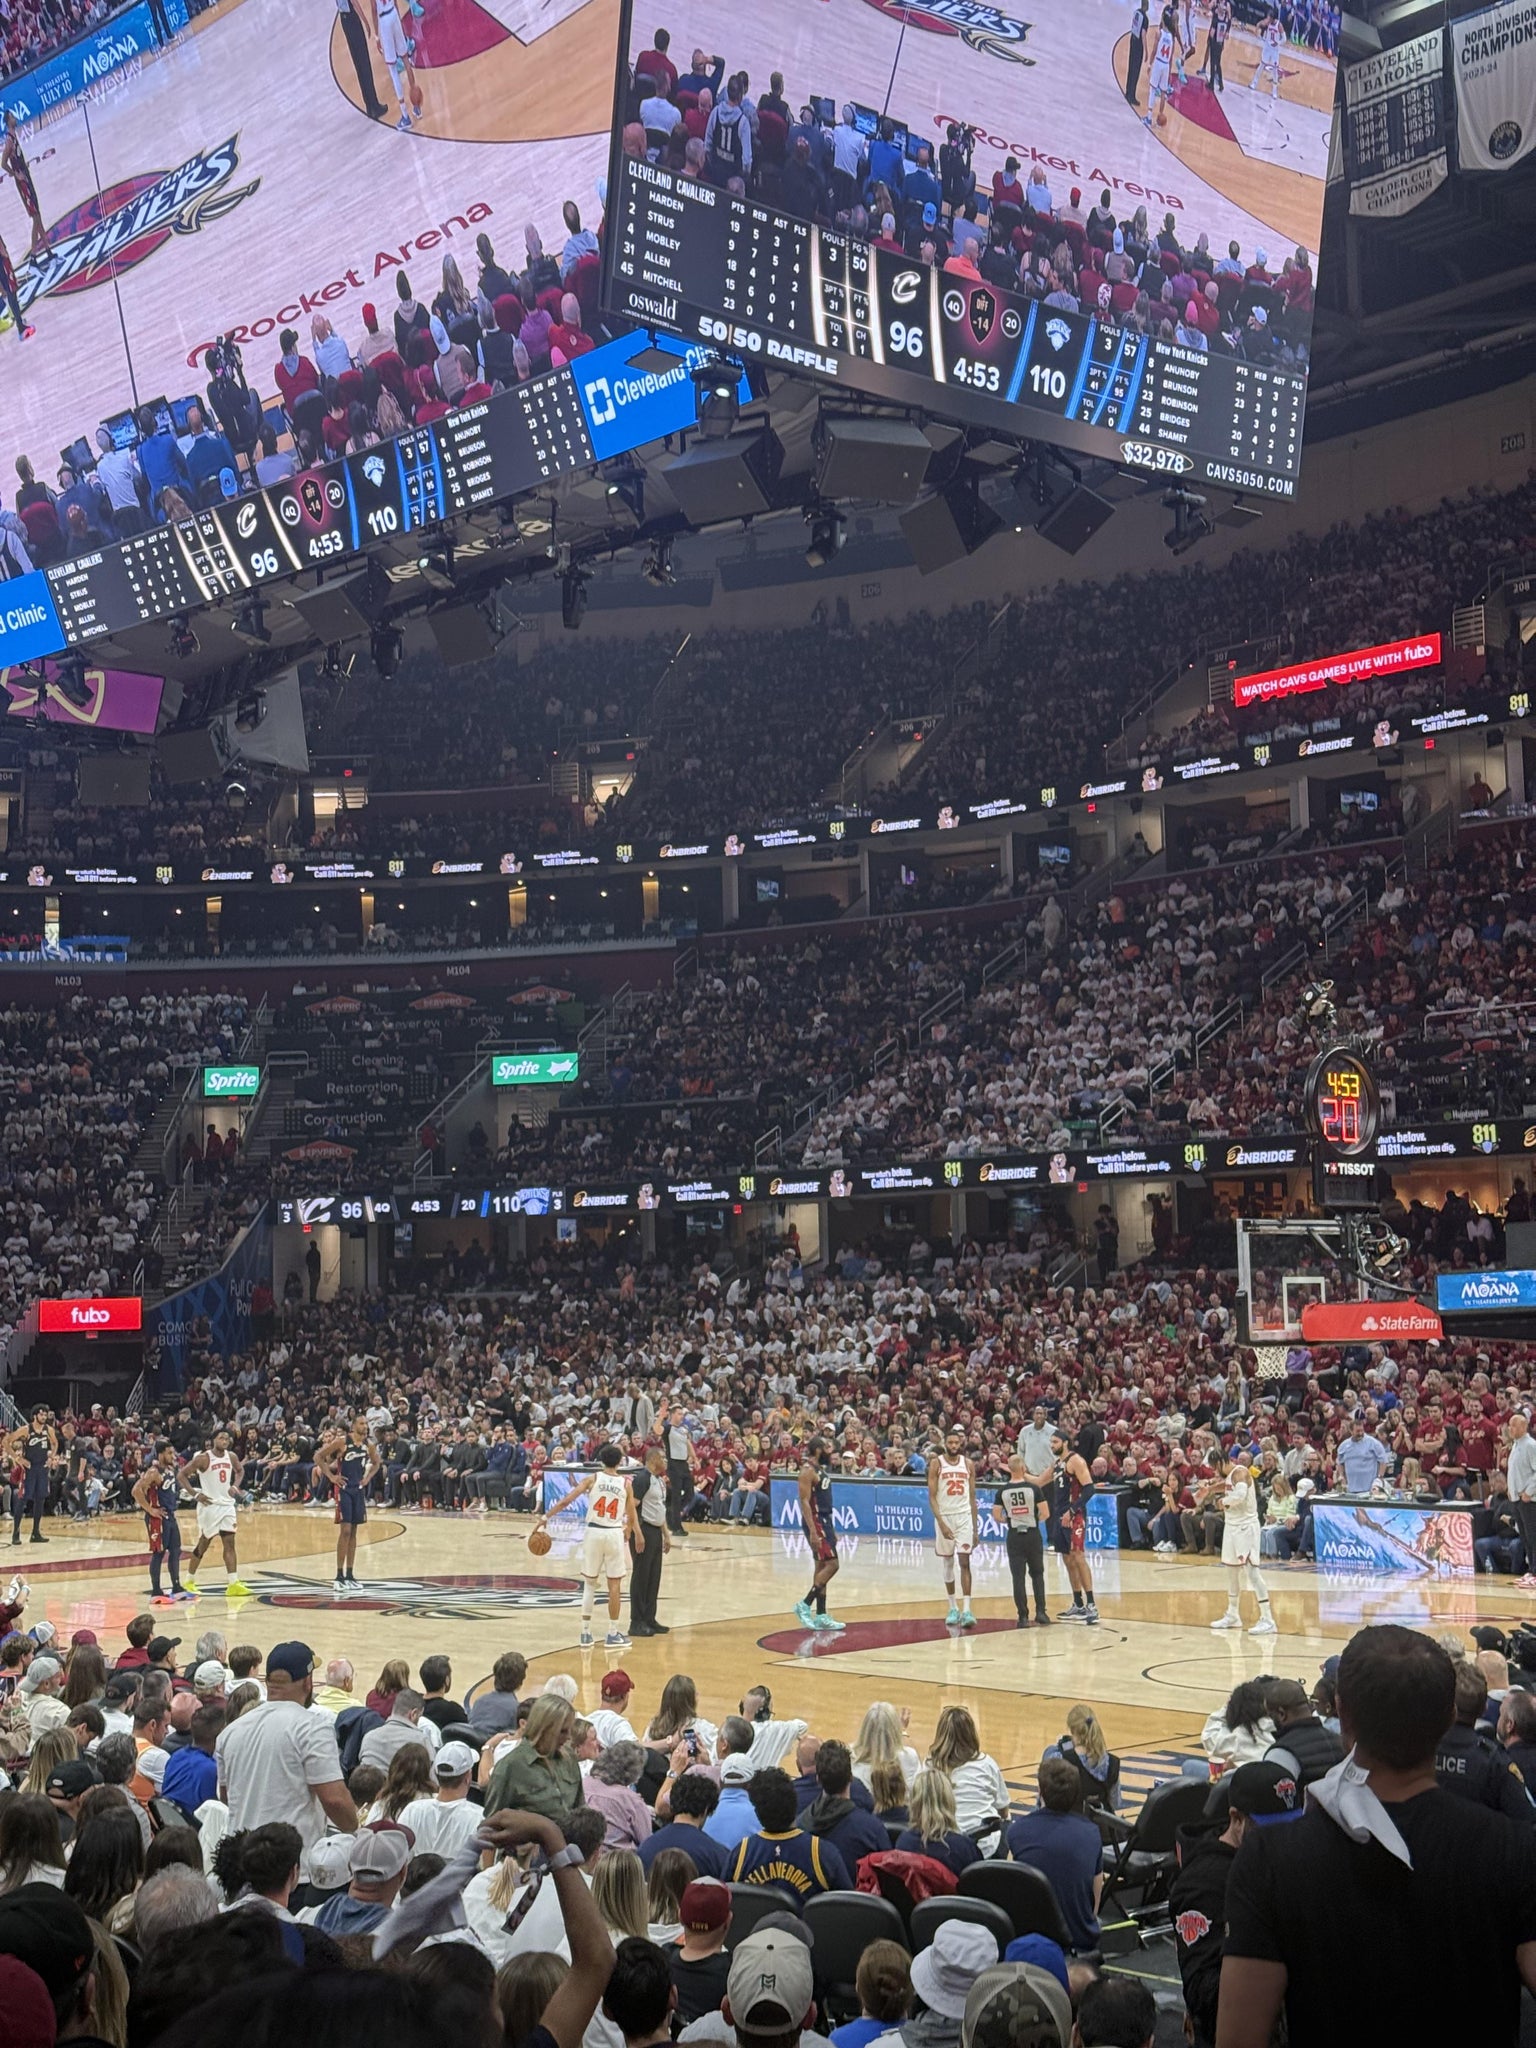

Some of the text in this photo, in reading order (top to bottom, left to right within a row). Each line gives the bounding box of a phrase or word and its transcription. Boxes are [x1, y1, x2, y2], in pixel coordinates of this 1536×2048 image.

[1465, 24, 1494, 46] NORTH
[82, 34, 139, 84] MOANA
[1348, 37, 1438, 82] CLEVELAND
[44, 71, 70, 91] THEATERS
[1364, 58, 1424, 93] BARONS
[40, 79, 72, 110] JULY 10
[970, 126, 1184, 211] Rocket Arena
[628, 160, 716, 206] CLEVELAND CAVALIERS
[1366, 167, 1432, 200] CALDER CUP
[1368, 180, 1432, 210] CHAMPIONS
[632, 182, 800, 254] 1 HARDEN 19 5 1
[731, 201, 807, 236] PTS REB AST FLS
[628, 202, 800, 274] 2 STRUS 9 7 4
[822, 232, 845, 246] FOULS
[627, 222, 798, 292] 4 MOBLEY 18 4 2
[829, 248, 867, 272] 3 50
[224, 201, 494, 344] Rocket Arena
[623, 241, 795, 311] 31 ALLEN 15 6 1
[620, 261, 794, 330] 45 MITCHELL 23 0 4
[629, 293, 676, 320] oswald
[830, 300, 864, 320] 31 61
[948, 300, 1016, 330] 4Q 20
[972, 317, 989, 332] -14
[1100, 324, 1120, 338] FOULS
[890, 320, 923, 358] 96
[1104, 338, 1136, 358] 3 57
[767, 339, 838, 376] RAFFLE
[1156, 342, 1208, 366] New York Knicks
[953, 357, 1066, 399] 4:53 110
[1148, 358, 1245, 392] 8 ANUNOBY 21
[1236, 366, 1303, 390] PTS REB AST FLS
[1146, 374, 1245, 410] 11 BRUNSON 23
[1142, 390, 1239, 424] 23 ROBINSON 2
[1140, 406, 1242, 441] 25 BRIDGES 20
[1138, 422, 1239, 456] 44 SHAMET 12
[1124, 441, 1294, 496] $32,978 CAVS5050.COM
[329, 488, 340, 500] 20
[285, 506, 297, 518] 4Q
[368, 506, 398, 536] 110
[251, 530, 344, 578] 96 4:53
[6, 603, 47, 631] Clinic
[1240, 645, 1433, 698] WATCH CAVS GAMES LIVE WITH fubo
[1509, 693, 1529, 711] 811
[1254, 736, 1354, 762] 811 ENBRIDGE
[1041, 781, 1126, 802] 811 ENBRIDGE
[55, 976, 82, 986] M103
[446, 965, 471, 976] M104
[207, 1072, 257, 1090] Sprite
[496, 1060, 540, 1080] Sprite
[1327, 1072, 1360, 1098] 4:53
[1322, 1098, 1360, 1144] 20
[1472, 1123, 1497, 1144] 811
[1184, 1144, 1297, 1166] 811 ENBRIDGE
[1388, 1144, 1401, 1156] 811
[944, 1162, 962, 1179] 811
[988, 1166, 1038, 1181] ENBRIDGE
[1338, 1162, 1375, 1176] TISSOT
[341, 1196, 521, 1218] 96 4Q 4:53 20 110
[1461, 1282, 1520, 1299] MOANA
[71, 1306, 110, 1324] fubo
[218, 1469, 226, 1483] 8
[946, 1480, 965, 1496] 25
[592, 1496, 619, 1520] 44
[874, 1505, 923, 1516] IN THEATERS
[1010, 1491, 1026, 1506] 39
[876, 1515, 923, 1533] JULY 10
[1086, 1526, 1102, 1543] 10
[1322, 1540, 1376, 1560] MOANA
[1434, 1755, 1466, 1774] LICE
[744, 1861, 813, 1894] ELLAVEDOVA
